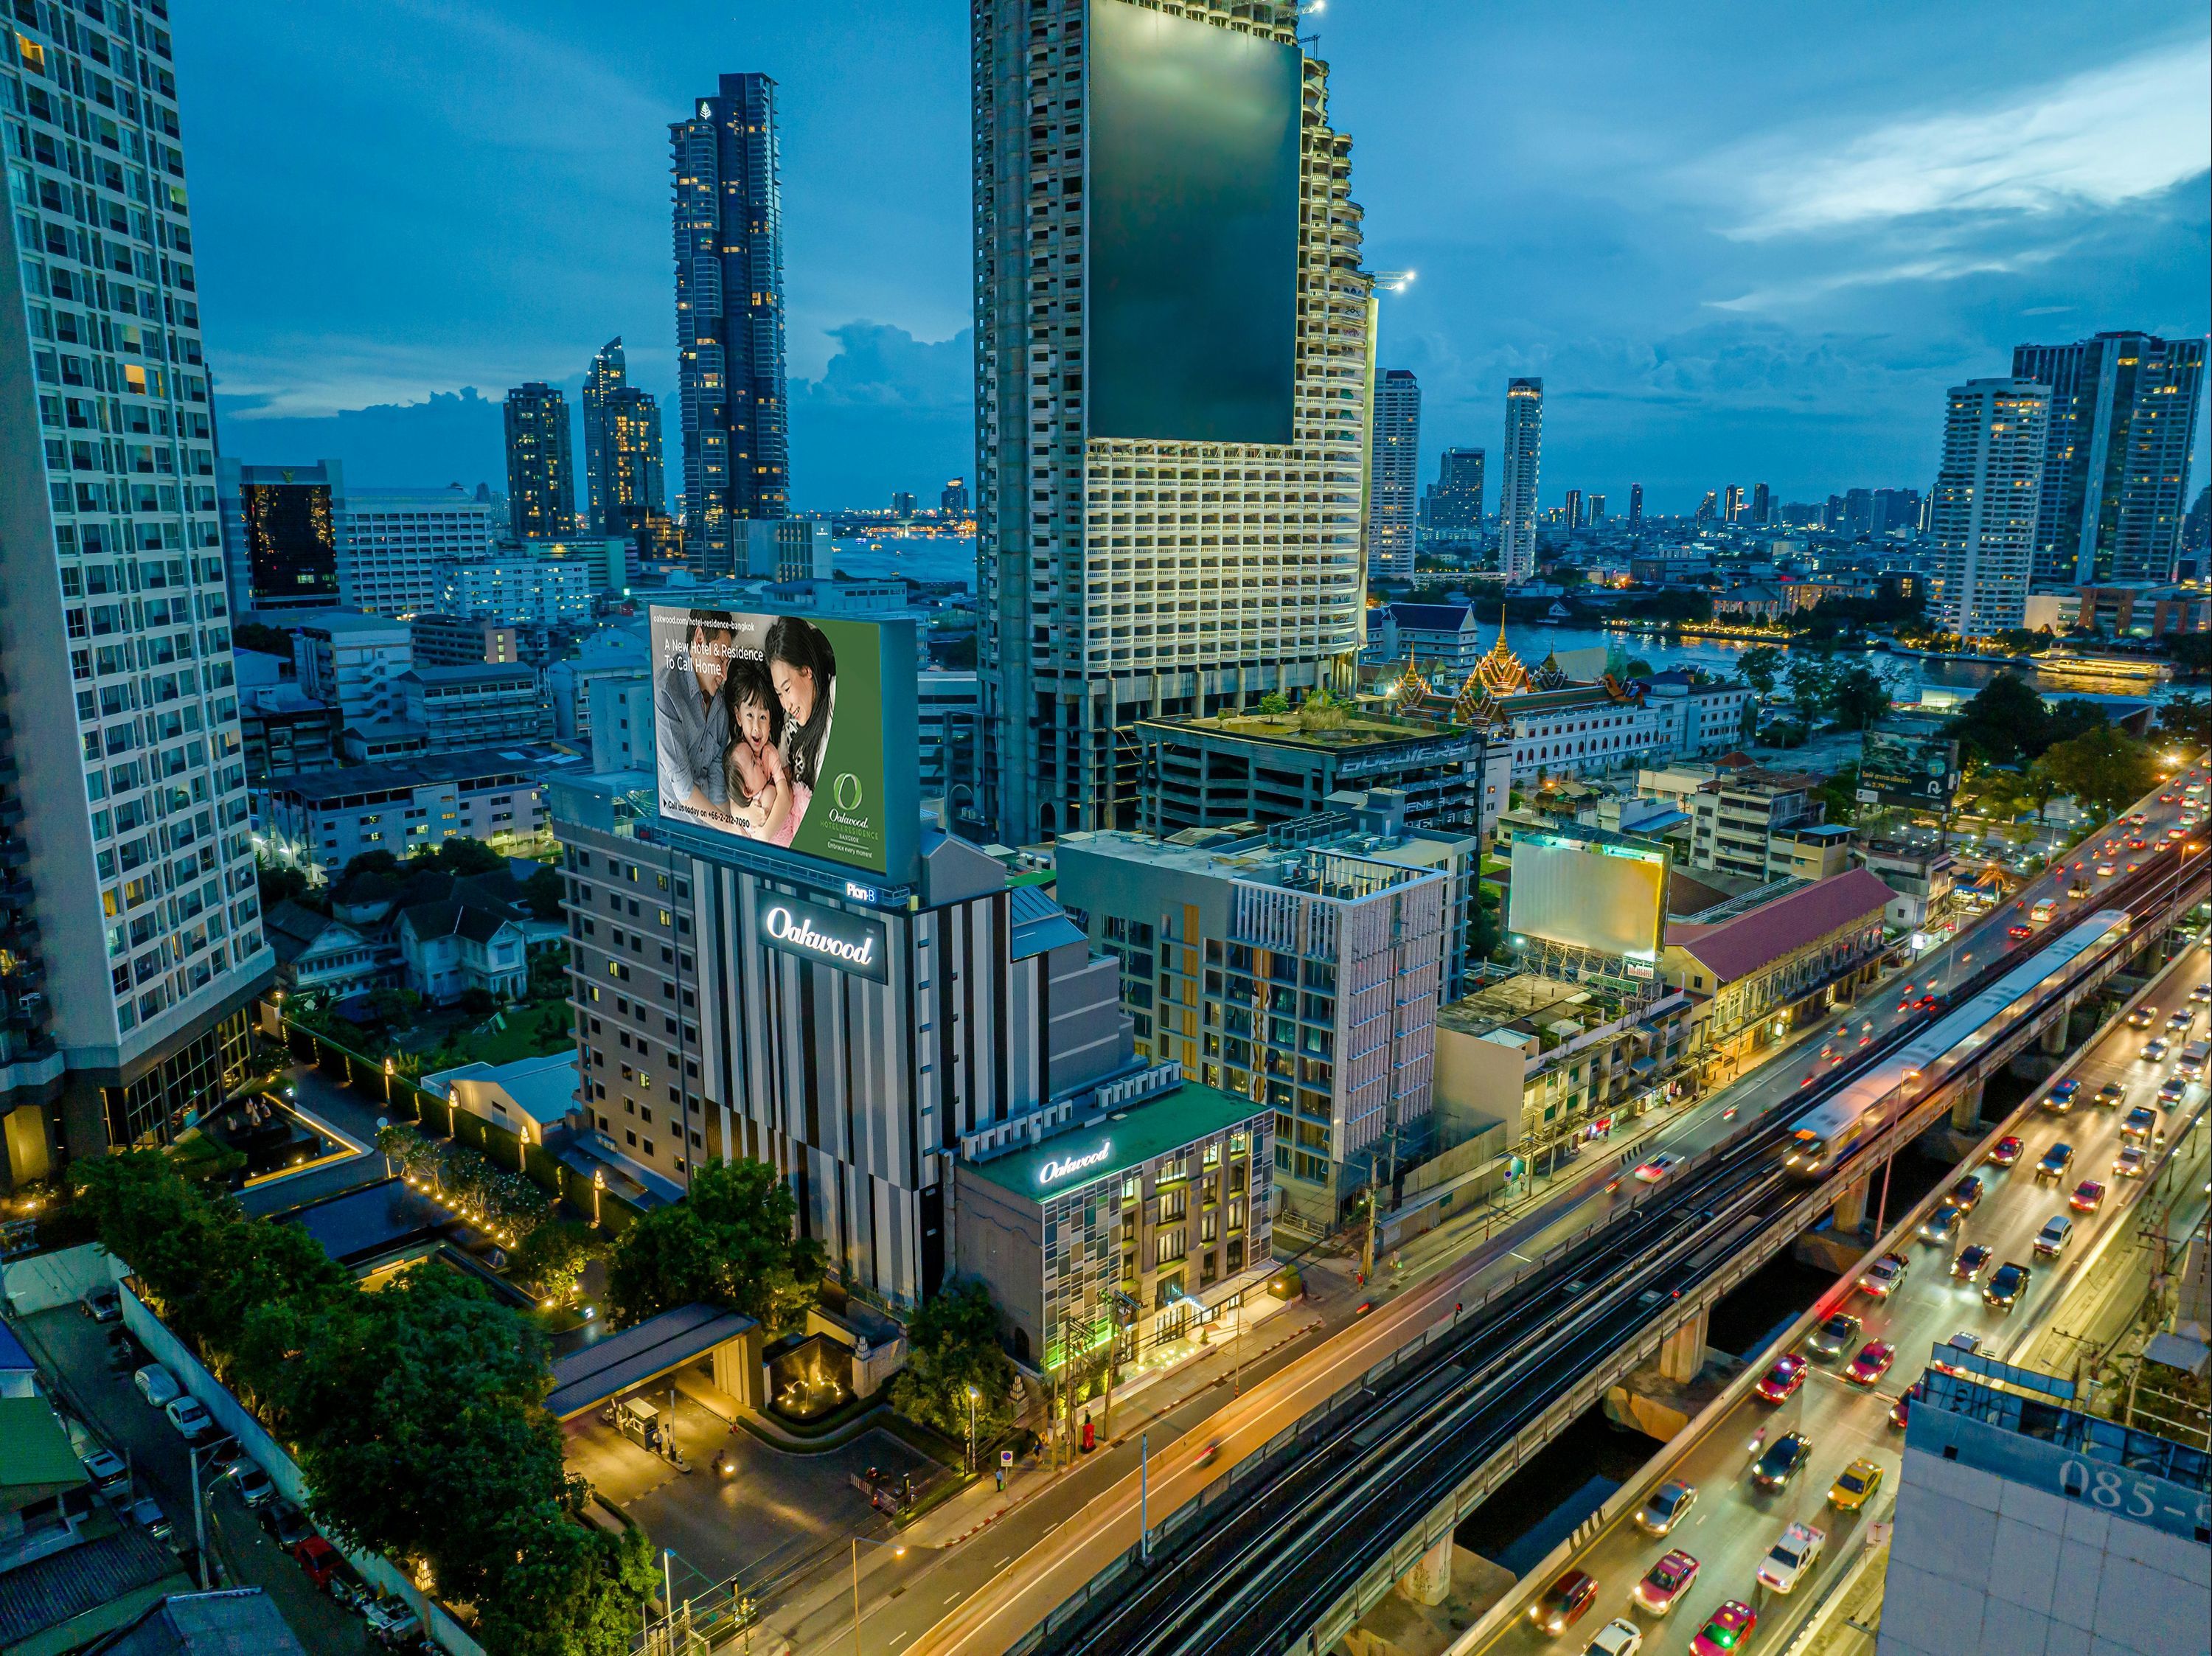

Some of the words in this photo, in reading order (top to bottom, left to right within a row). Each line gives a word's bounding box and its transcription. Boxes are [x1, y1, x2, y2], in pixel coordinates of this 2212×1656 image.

[653, 614, 755, 632] oakwood.com/hotel-residence-bangkok
[664, 638, 670, 650] A
[672, 639, 689, 653] New
[691, 641, 712, 655] Hotel
[714, 644, 720, 655] &
[722, 644, 764, 661] Residence
[664, 655, 675, 669] To
[677, 656, 693, 672] Call
[695, 658, 722, 675] Home
[668, 801, 677, 810] Call
[685, 805, 699, 817] today
[700, 810, 707, 818] on
[708, 812, 750, 829] +66-2-212-7090
[829, 808, 868, 828] Oakwood
[820, 821, 839, 830] HOTEL
[844, 826, 878, 840] RESIDENCE
[767, 908, 872, 965] Oakwood
[1040, 1141, 1110, 1184] Oakwood
